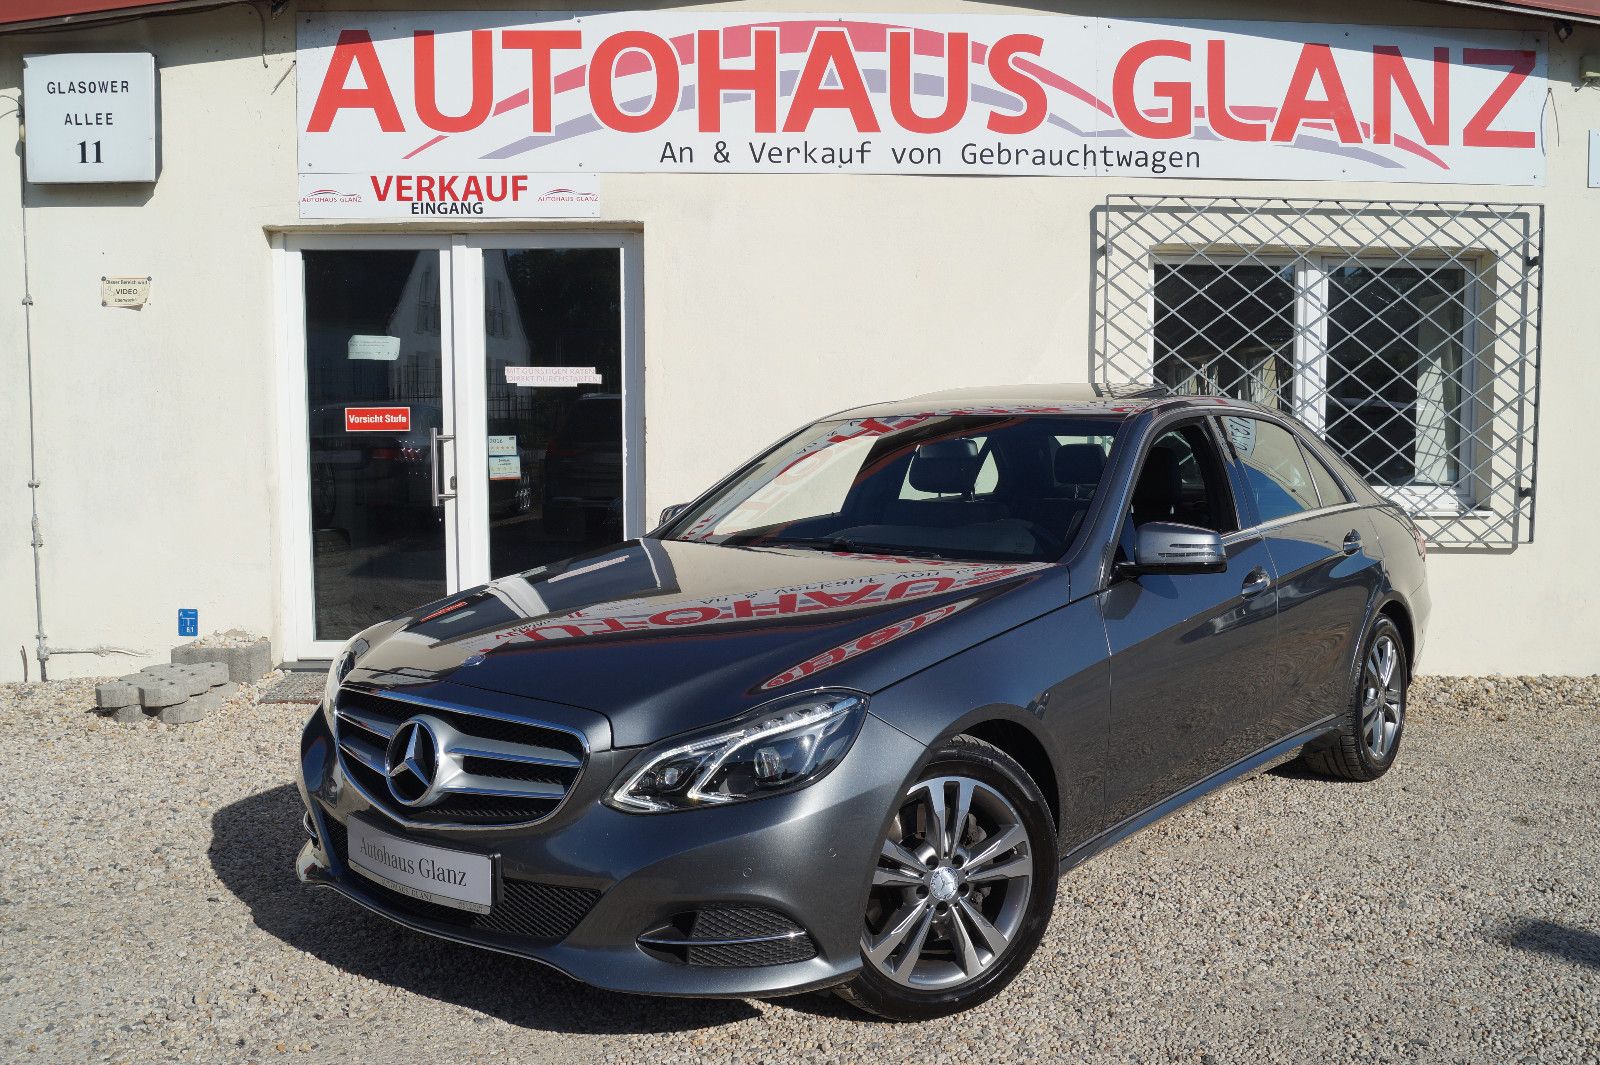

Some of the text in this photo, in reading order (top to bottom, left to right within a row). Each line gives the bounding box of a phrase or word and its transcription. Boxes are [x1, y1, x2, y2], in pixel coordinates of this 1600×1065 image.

[46, 80, 129, 94] GLASOWER
[305, 29, 1536, 149] AUTOHAUS GLANZ
[64, 112, 114, 126] ALLEE
[77, 140, 104, 164] 11
[659, 140, 1200, 174] An & Verkauf von Gebrauchtwagen
[369, 174, 529, 202] VERKAUF
[411, 201, 484, 215] EINGANG
[348, 413, 407, 424] Vorsicht Stufe
[360, 836, 467, 887] Autohaus Glanz
